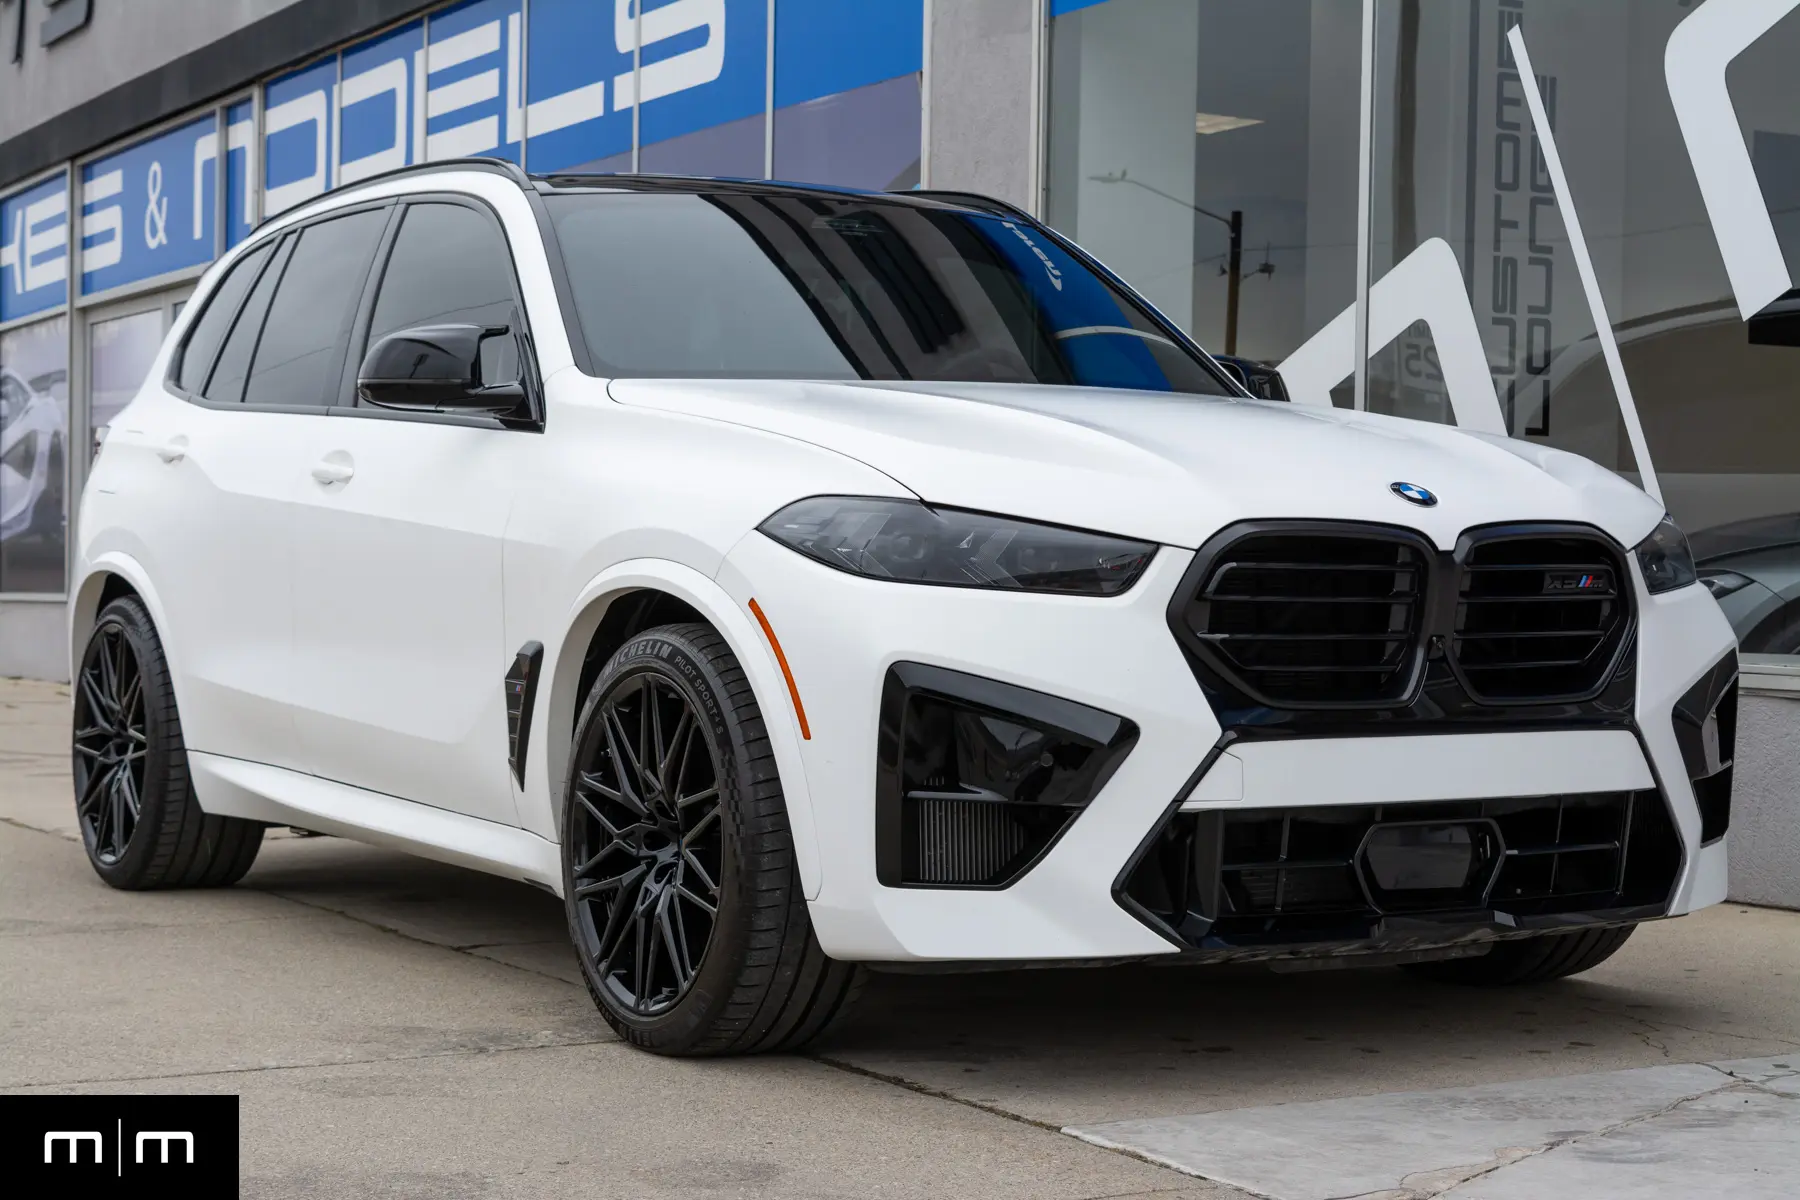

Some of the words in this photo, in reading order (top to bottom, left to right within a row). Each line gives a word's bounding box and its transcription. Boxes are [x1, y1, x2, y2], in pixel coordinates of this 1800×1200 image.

[145, 161, 168, 249] &
[602, 641, 673, 680] MICHELIN
[674, 655, 697, 679] PILOT
[694, 679, 718, 716] SPORT
